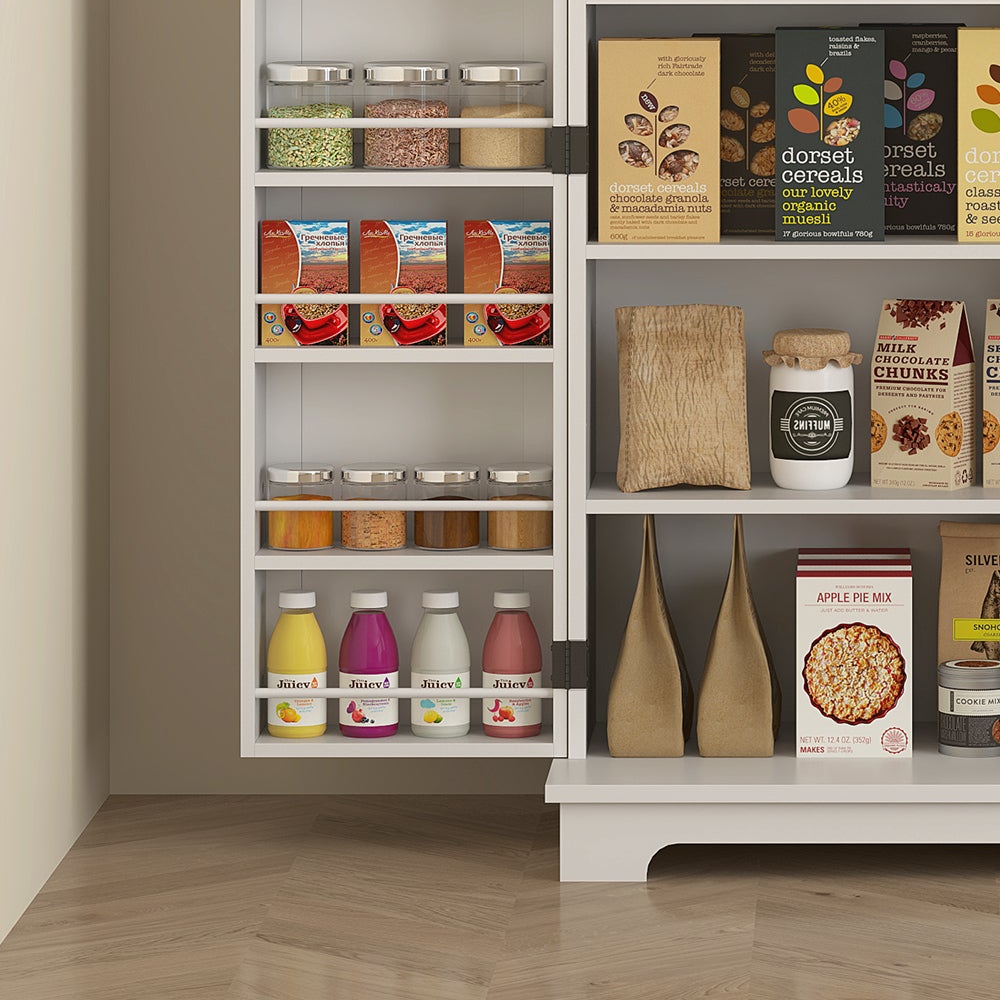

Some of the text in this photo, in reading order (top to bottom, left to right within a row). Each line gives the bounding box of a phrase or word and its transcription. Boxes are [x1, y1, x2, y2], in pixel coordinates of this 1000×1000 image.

[641, 93, 656, 111] new
[782, 147, 854, 164] dorset
[884, 142, 937, 158] orset
[782, 167, 864, 184] cereals
[721, 176, 776, 187] rset cere
[610, 182, 707, 193] dorset cereals
[610, 194, 709, 204] chocolate granola
[782, 187, 853, 200] our lovely
[610, 204, 619, 213] &
[622, 204, 685, 213] macadamia
[782, 200, 837, 213] organic
[782, 214, 831, 225] muesli
[965, 214, 978, 224] &
[877, 343, 917, 354] MILK
[874, 356, 950, 366] CHOCOLATE
[874, 367, 949, 380] CHUNKS
[817, 593, 892, 603] APPLE PIE MIX
[852, 736, 872, 744] (352g)
